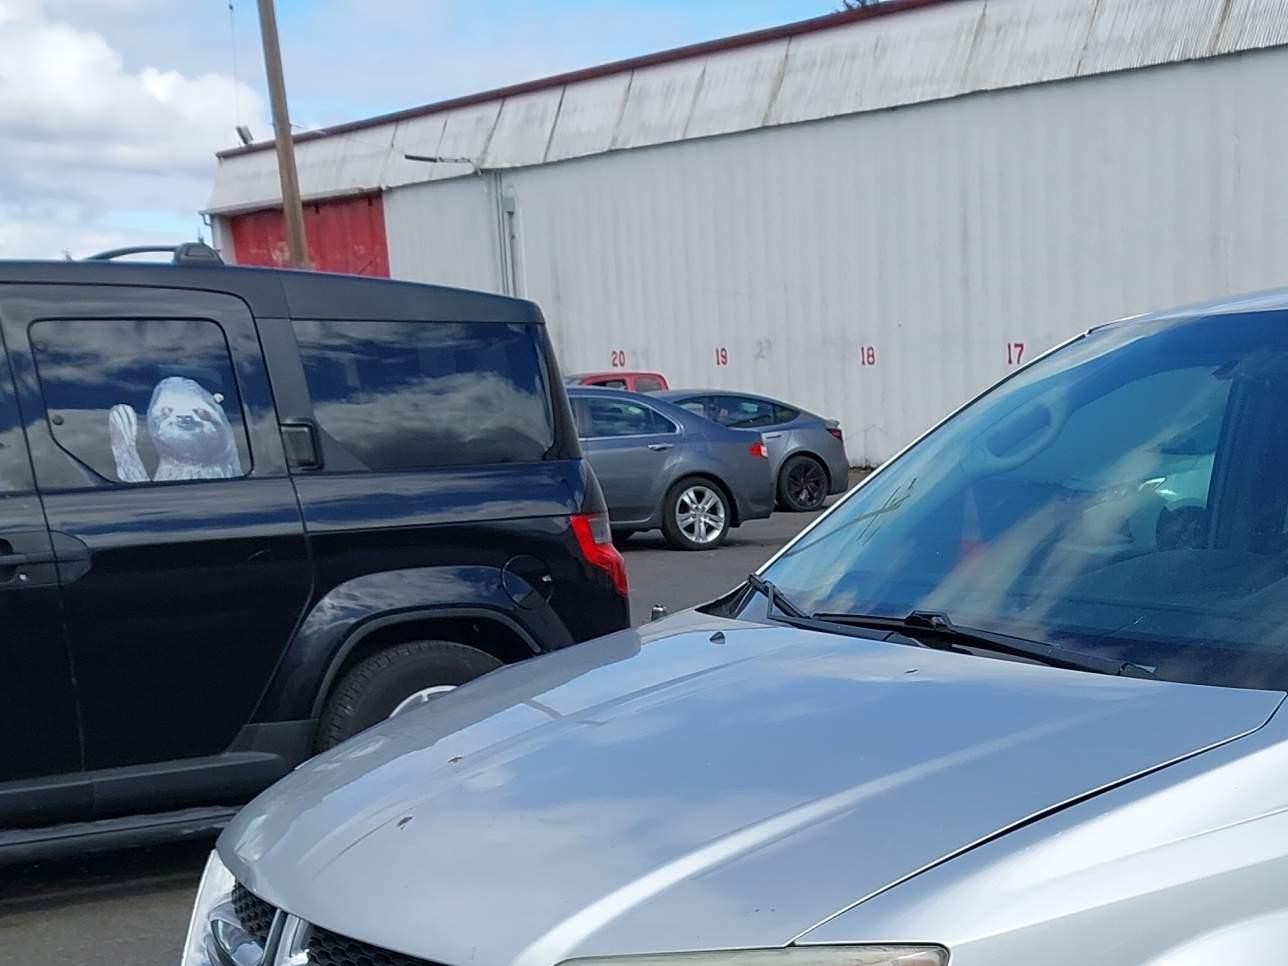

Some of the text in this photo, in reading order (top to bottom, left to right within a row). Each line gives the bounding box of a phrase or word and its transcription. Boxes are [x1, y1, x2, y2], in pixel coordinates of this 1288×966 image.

[611, 349, 626, 367] 20
[715, 347, 728, 366] 19
[860, 346, 876, 366] 18
[1007, 342, 1024, 364] 17
